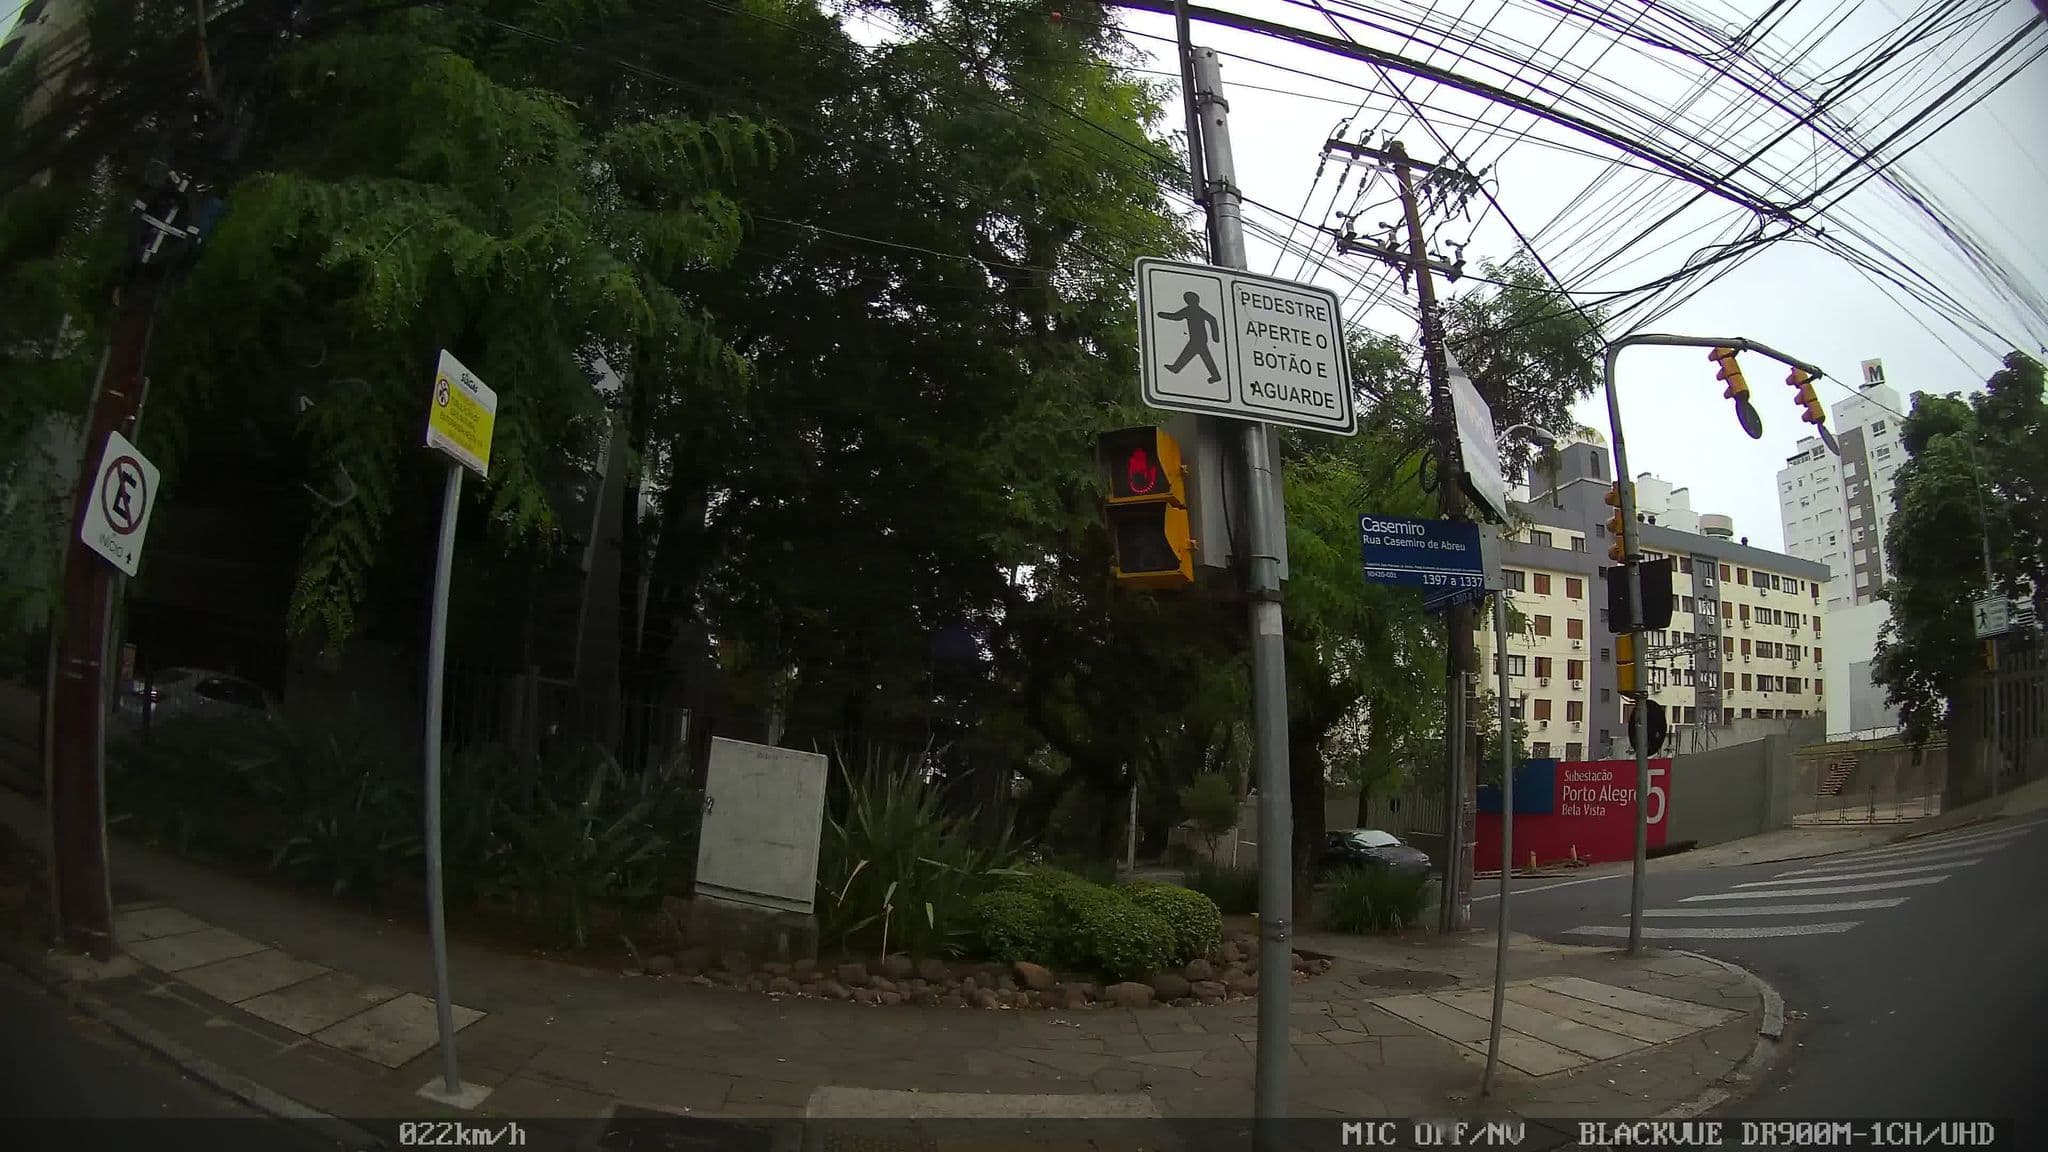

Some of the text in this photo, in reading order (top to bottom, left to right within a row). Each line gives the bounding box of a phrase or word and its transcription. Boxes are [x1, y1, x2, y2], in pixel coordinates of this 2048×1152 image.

[1240, 291, 1328, 323] PEDESTRE
[1246, 321, 1328, 350] APERTE O
[1253, 350, 1328, 379] BOTÃO E
[1251, 381, 1335, 410] AGUARDE
[1361, 516, 1425, 536] Casemiro
[1363, 535, 1466, 551] Rua Casemiro de Abreu
[1422, 575, 1483, 588] 1397 a 1337
[1563, 785, 1596, 802] Porto
[1646, 768, 1666, 825] 5
[1562, 803, 1606, 816] Bela Vista
